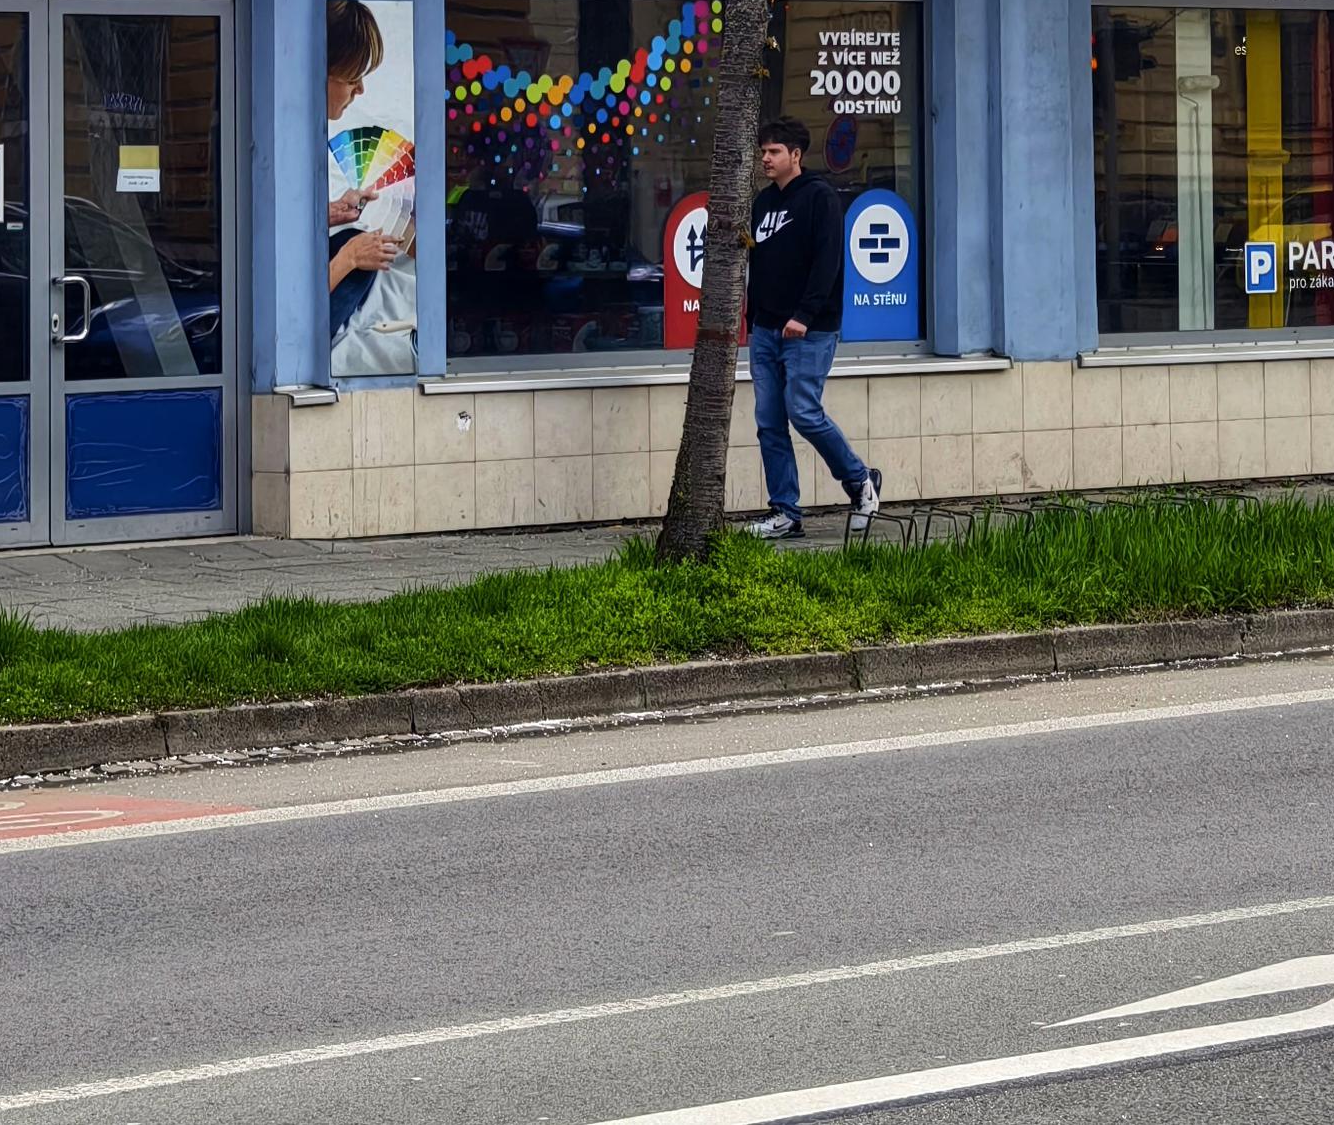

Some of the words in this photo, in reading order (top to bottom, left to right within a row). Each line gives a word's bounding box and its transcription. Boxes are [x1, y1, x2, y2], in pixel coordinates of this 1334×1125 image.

[819, 28, 900, 46] VYBÍREJTE
[818, 51, 828, 65] Z
[832, 48, 866, 65] VÍCE
[871, 47, 901, 65] NEŽ
[834, 95, 901, 114] ODSTÍNŮ
[1251, 251, 1272, 285] P
[1289, 277, 1307, 291] pro
[683, 299, 700, 312] NA
[854, 293, 870, 306] NA
[873, 291, 907, 305] STĚNU
